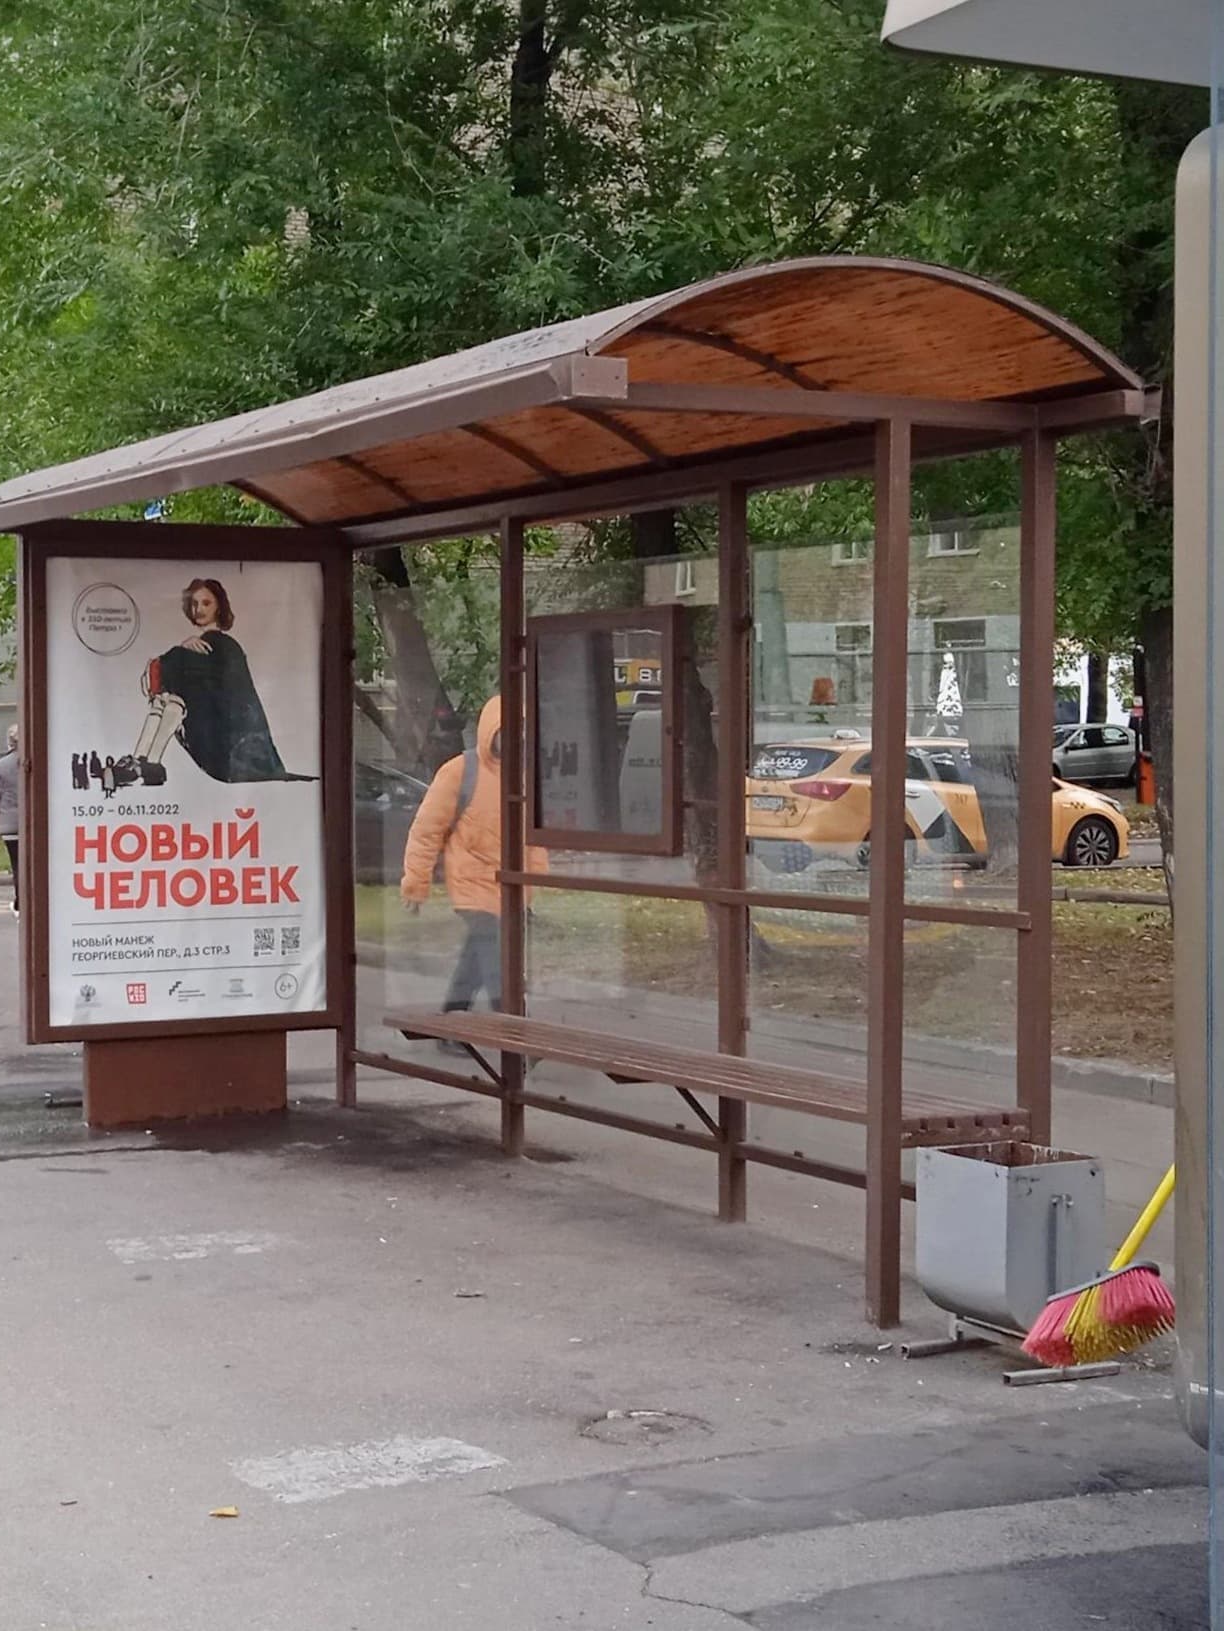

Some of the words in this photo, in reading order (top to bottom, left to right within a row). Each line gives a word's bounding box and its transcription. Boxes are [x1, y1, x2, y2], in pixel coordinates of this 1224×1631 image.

[72, 805, 104, 817] 15.09
[117, 804, 180, 816] 06.11.2022
[74, 807, 260, 864] НОВЫЙ
[72, 865, 301, 911] ЧЕЛОВЕК
[72, 934, 113, 949] НОВЫЙ
[115, 935, 155, 946] МАНЕЖ
[72, 946, 155, 962] ГЕОРГИЕВСКИЙ
